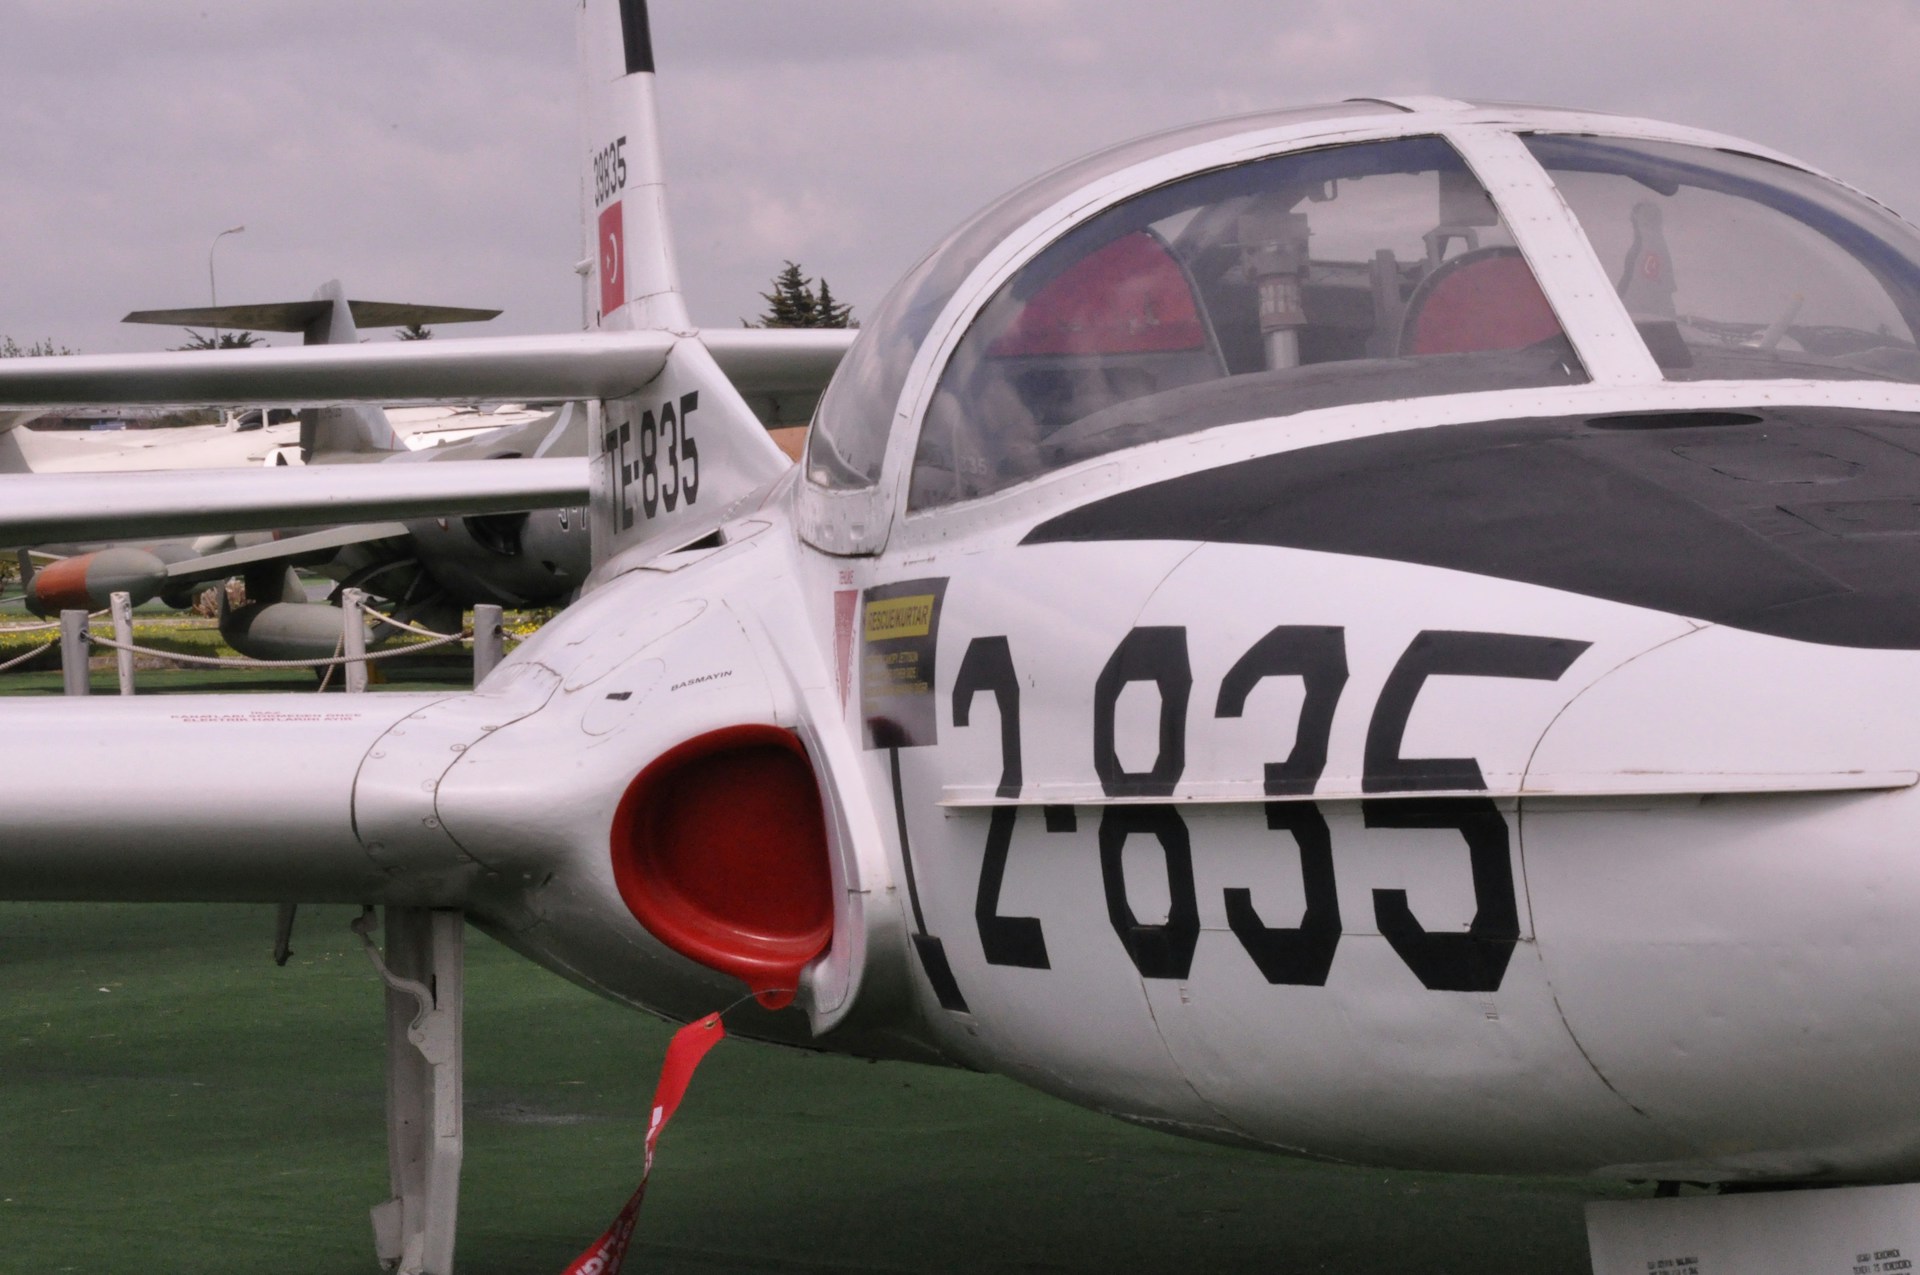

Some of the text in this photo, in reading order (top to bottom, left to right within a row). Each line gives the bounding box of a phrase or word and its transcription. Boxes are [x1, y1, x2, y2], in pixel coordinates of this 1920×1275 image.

[594, 136, 626, 208] 39835
[606, 390, 698, 535] TE-835
[671, 670, 732, 691] BASMAYIN
[952, 625, 1594, 991] 2-835
